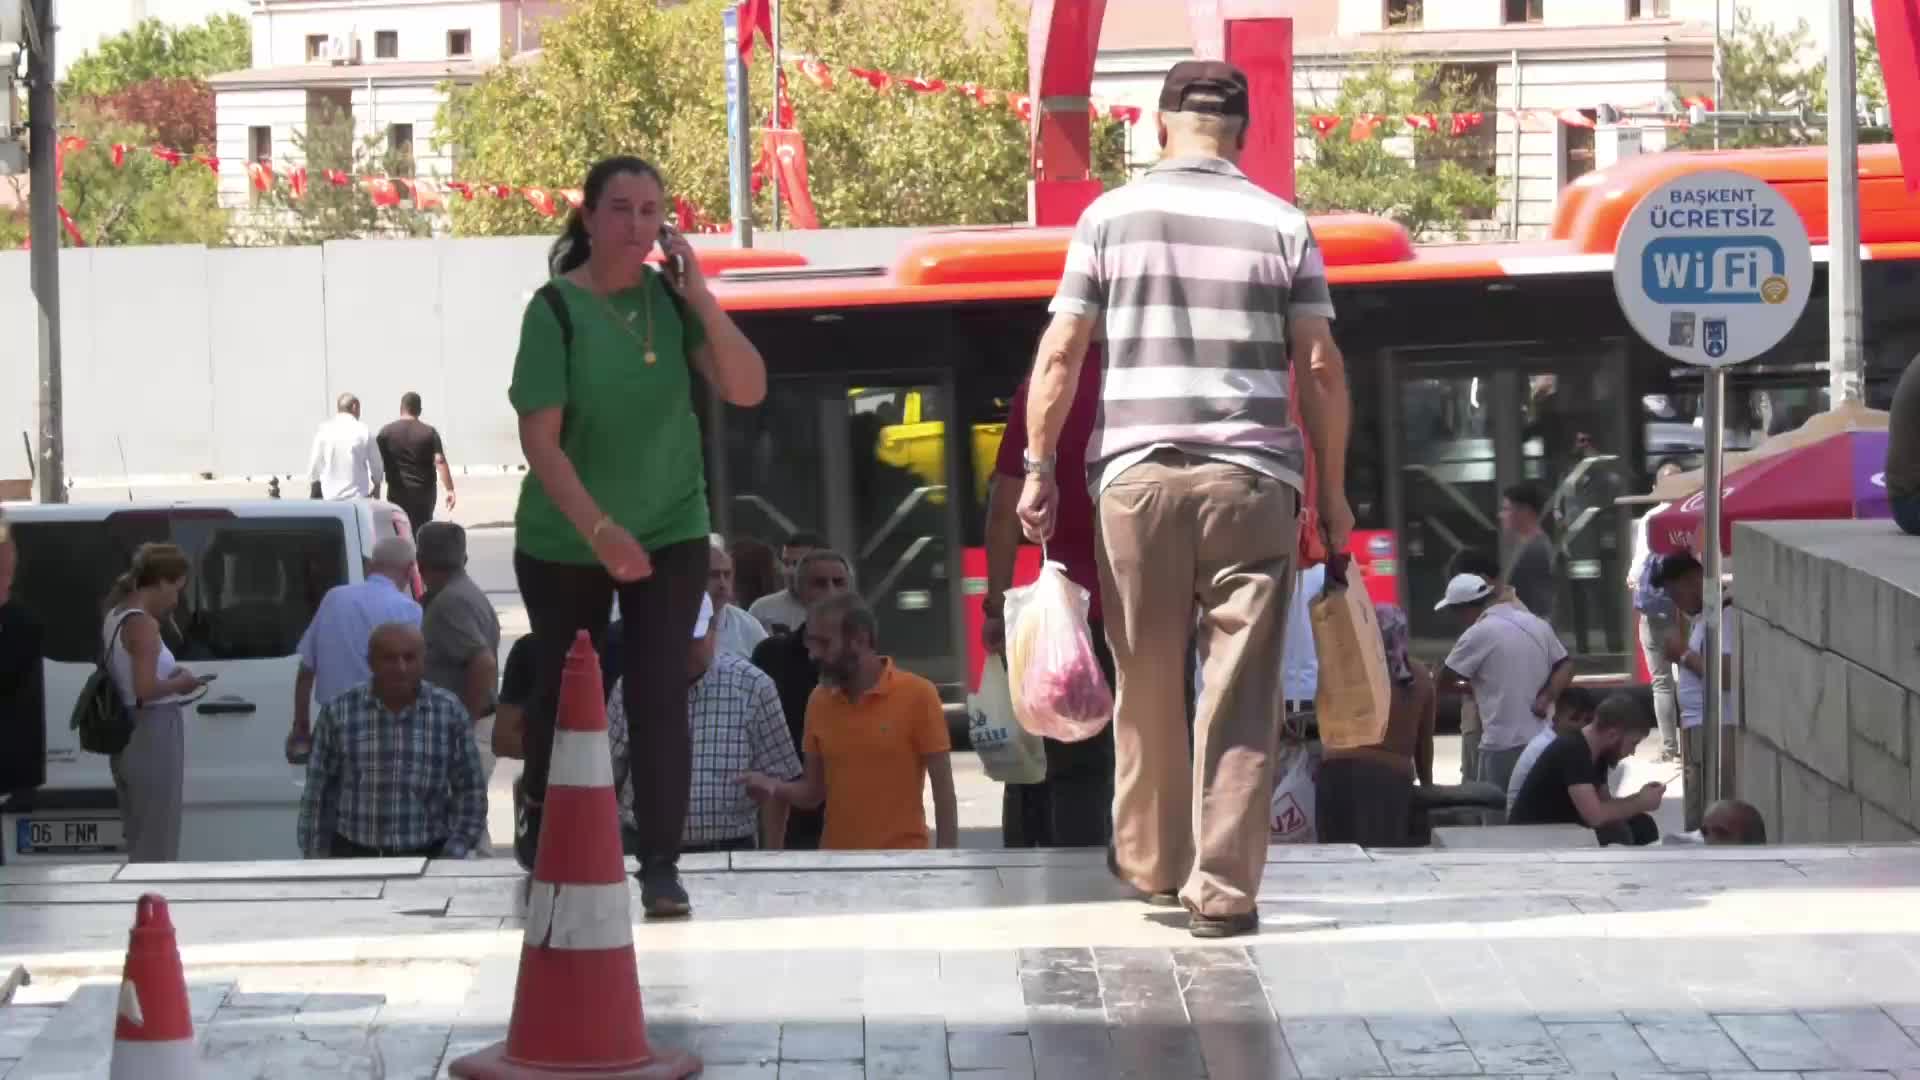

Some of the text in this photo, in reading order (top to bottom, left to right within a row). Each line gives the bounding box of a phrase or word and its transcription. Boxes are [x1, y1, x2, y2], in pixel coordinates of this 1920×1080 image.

[1670, 188, 1755, 206] BAŞKENT
[1650, 203, 1776, 228] ÜCRETSİZ
[32, 823, 52, 843] 06
